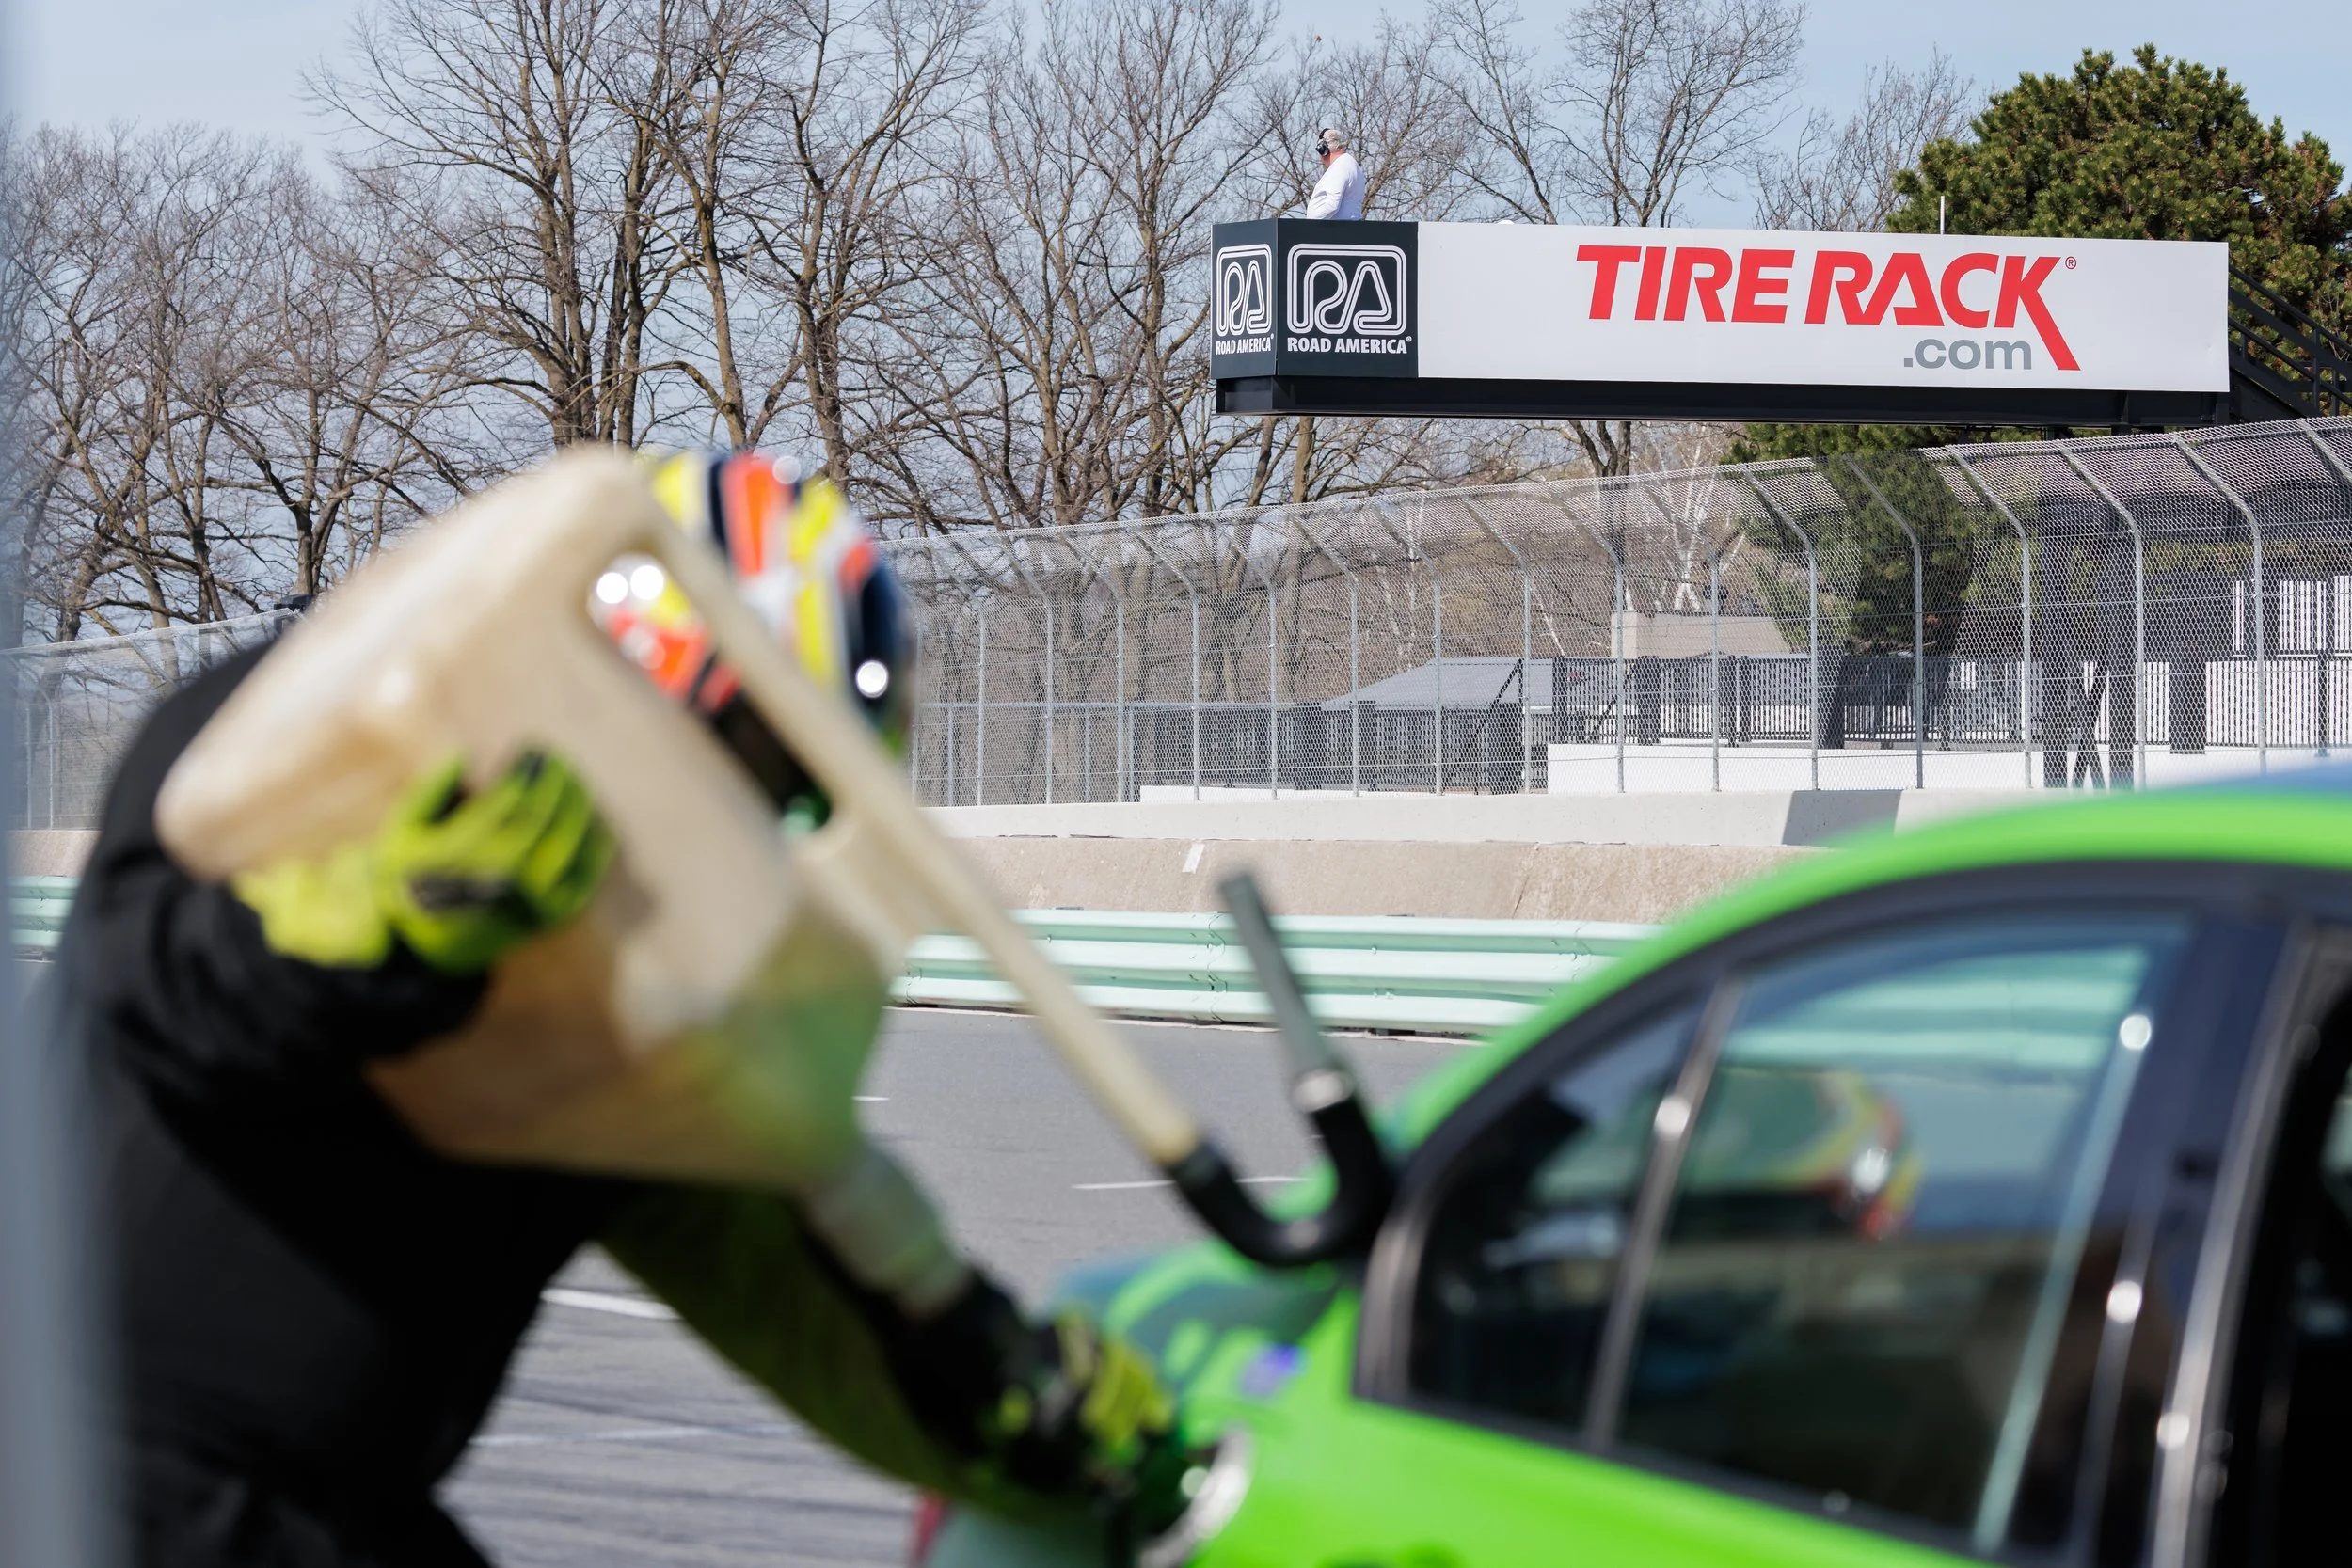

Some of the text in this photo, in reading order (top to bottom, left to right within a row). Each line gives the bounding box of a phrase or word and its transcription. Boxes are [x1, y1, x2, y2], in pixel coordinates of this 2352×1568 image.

[1576, 245, 2082, 372] TIRE RACK
[1216, 337, 1271, 356] ROAD AMERICA
[1287, 337, 1407, 355] ROAD AMERICA
[1903, 338, 2032, 370] .com
